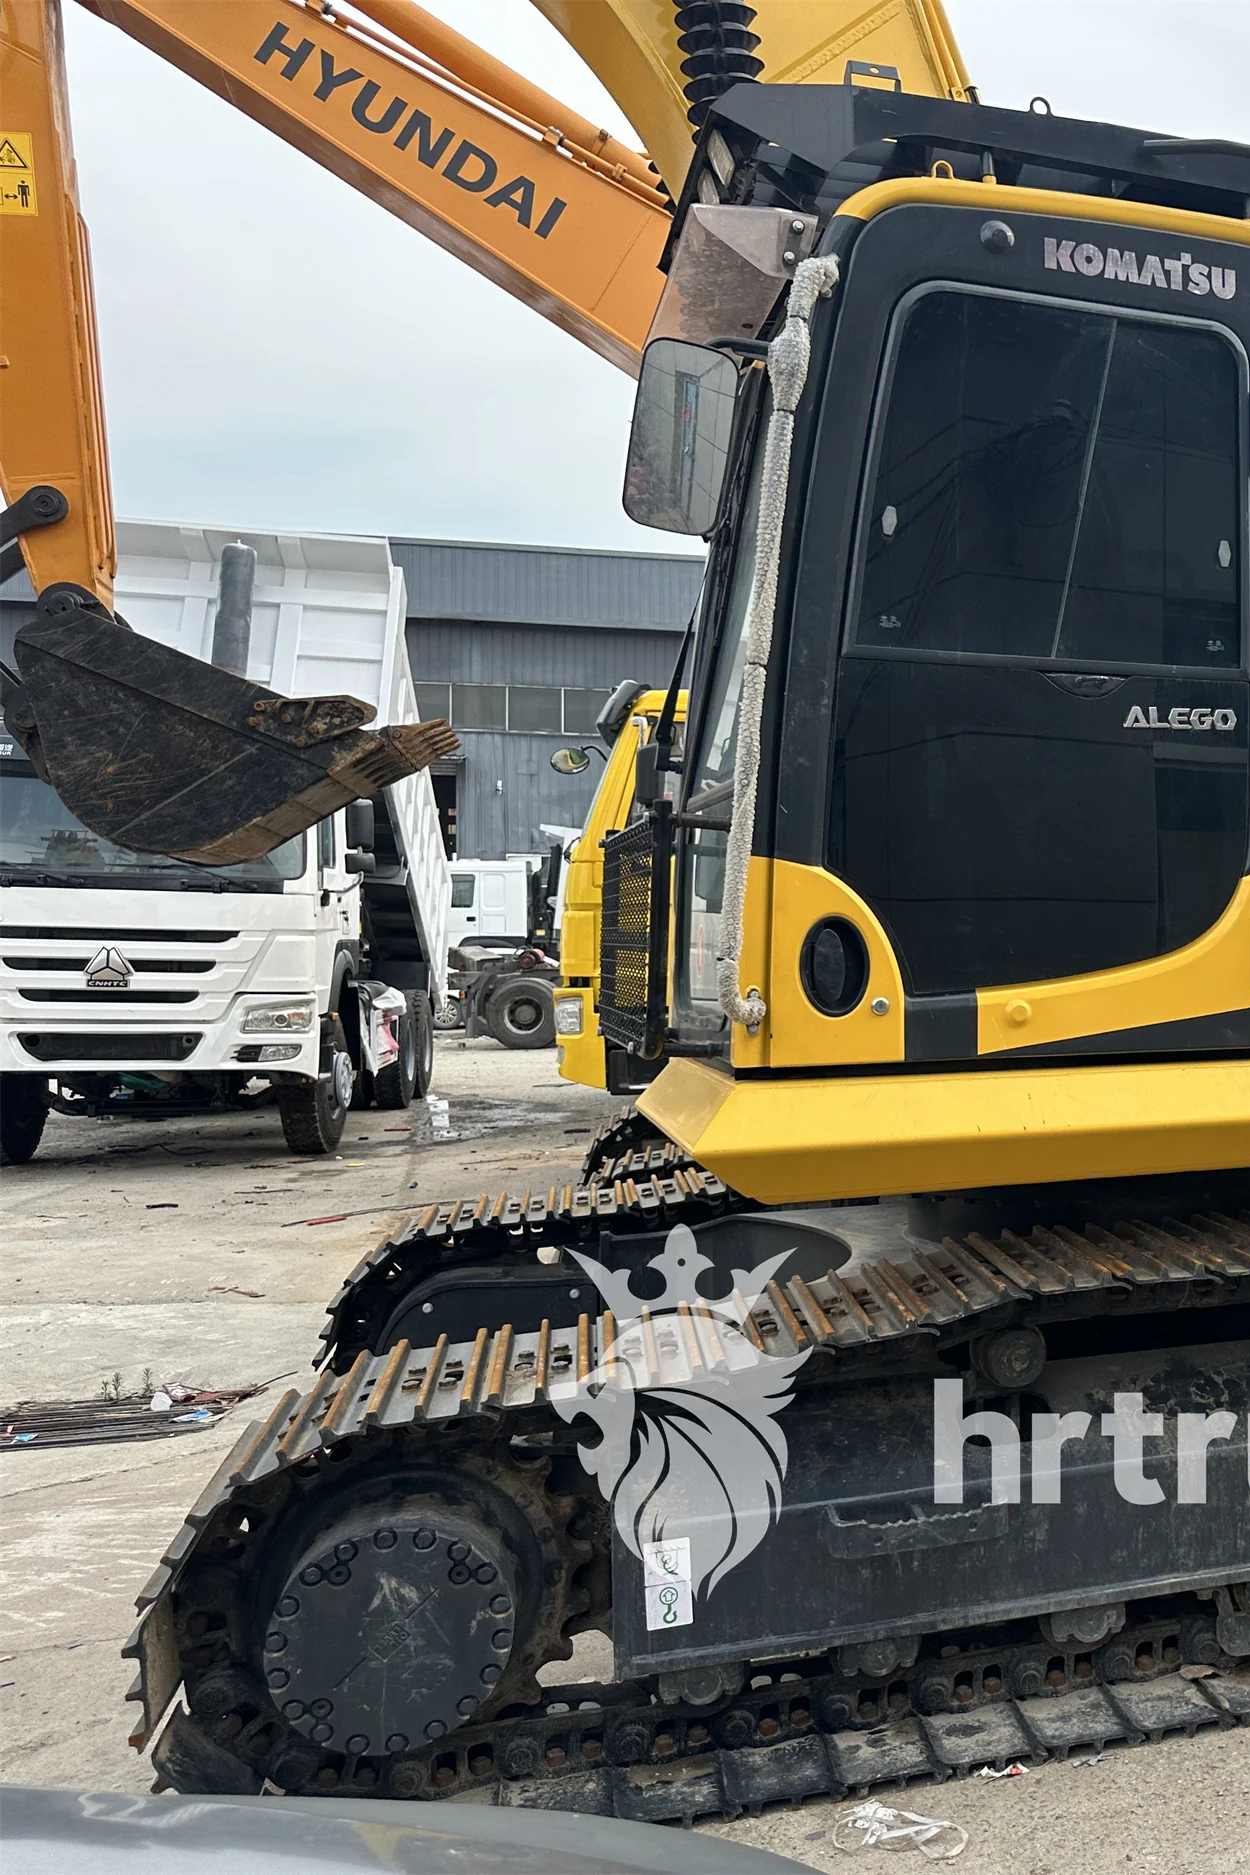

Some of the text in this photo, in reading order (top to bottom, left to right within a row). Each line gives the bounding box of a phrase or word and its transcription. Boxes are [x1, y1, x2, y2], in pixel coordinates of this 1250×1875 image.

[253, 21, 568, 240] HYUNDAI
[1044, 236, 1236, 300] KOMATSU
[1123, 705, 1238, 731] ALEGO
